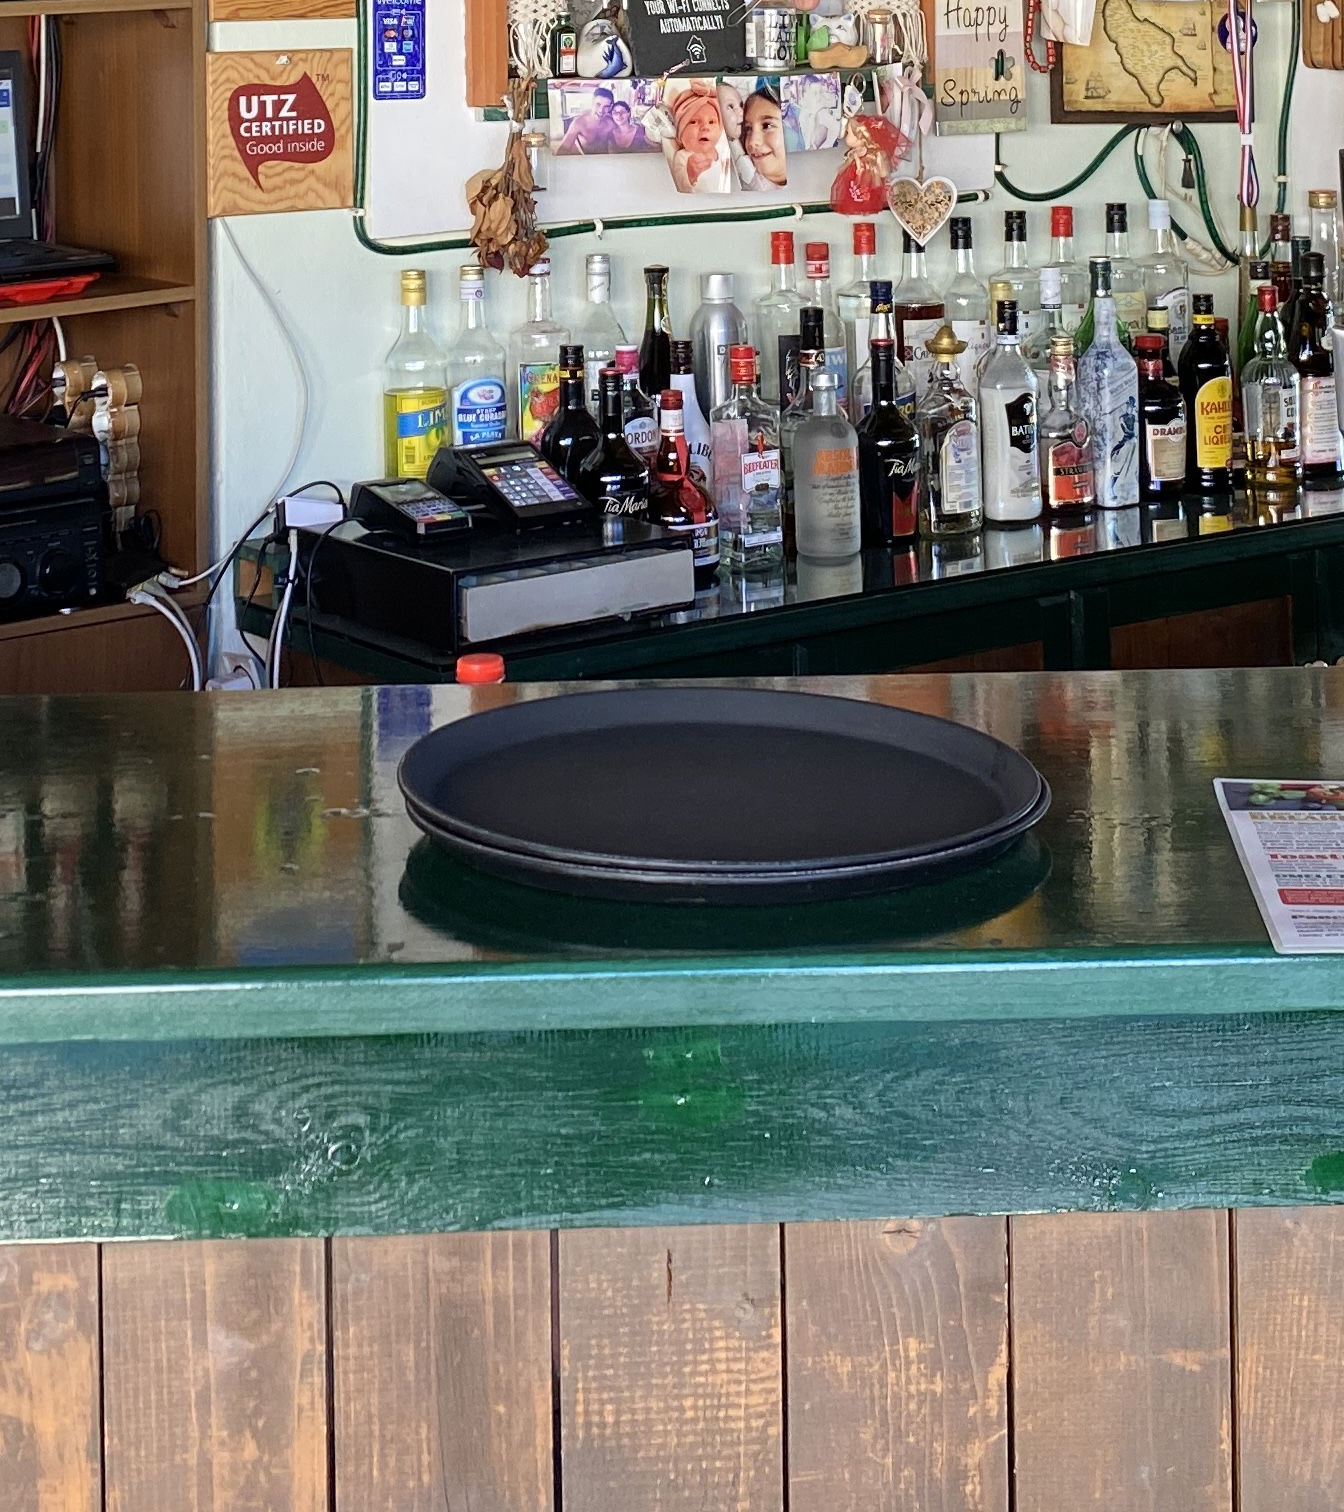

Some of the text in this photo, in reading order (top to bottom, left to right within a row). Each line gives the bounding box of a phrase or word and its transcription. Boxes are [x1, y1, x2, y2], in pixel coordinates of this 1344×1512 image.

[644, 0, 666, 15] YOUR
[383, 17, 398, 25] VISA
[660, 14, 725, 34] AUTOMATICALLY!
[316, 73, 331, 84] TM
[940, 79, 1022, 116] Spring
[238, 94, 299, 120] UTZ
[239, 119, 325, 137] CERTIFIED
[246, 137, 326, 155] Good inside
[744, 458, 779, 475] BEEFEATER
[599, 496, 620, 514] Tia
